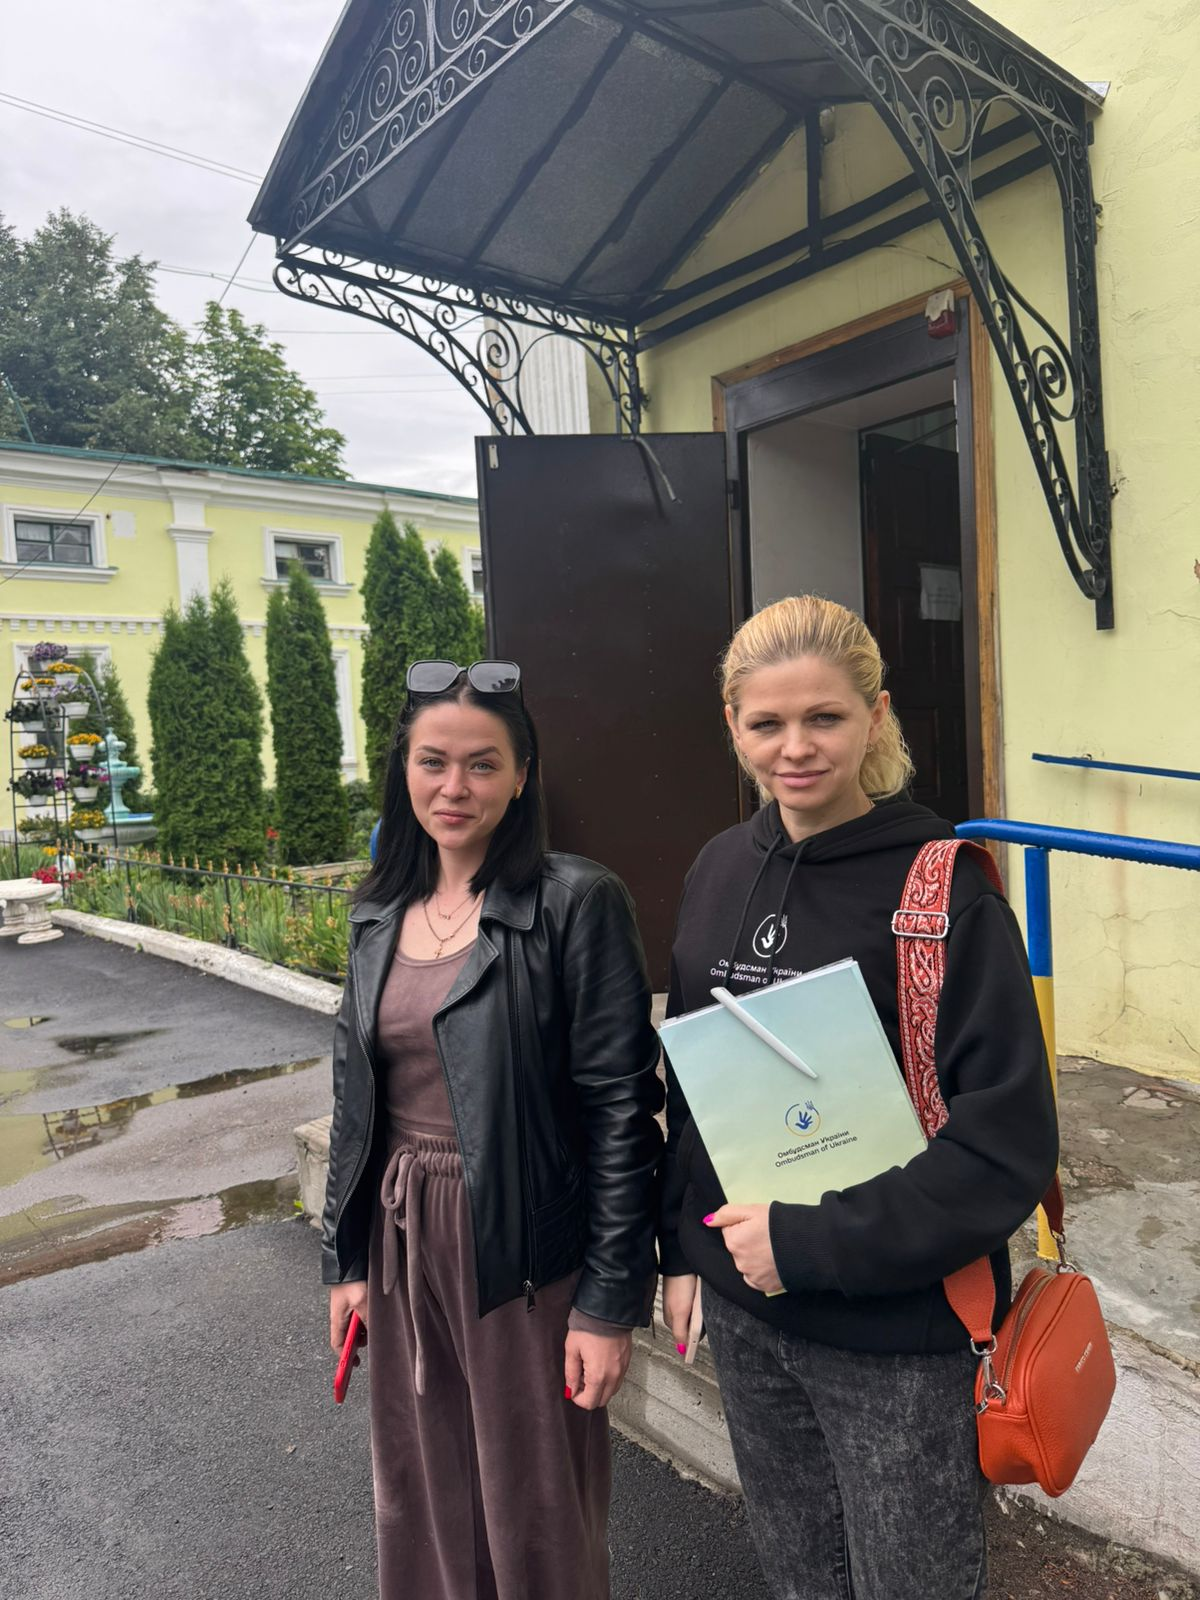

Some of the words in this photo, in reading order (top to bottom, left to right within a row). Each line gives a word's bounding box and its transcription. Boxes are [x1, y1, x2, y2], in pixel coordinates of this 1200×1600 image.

[772, 966, 803, 977] країни
[775, 1147, 820, 1168] Ombudsman
[820, 1144, 829, 1152] of
[829, 1136, 858, 1149] Ukraine
[777, 1140, 820, 1159] Омбудсман
[820, 1130, 850, 1144] України
